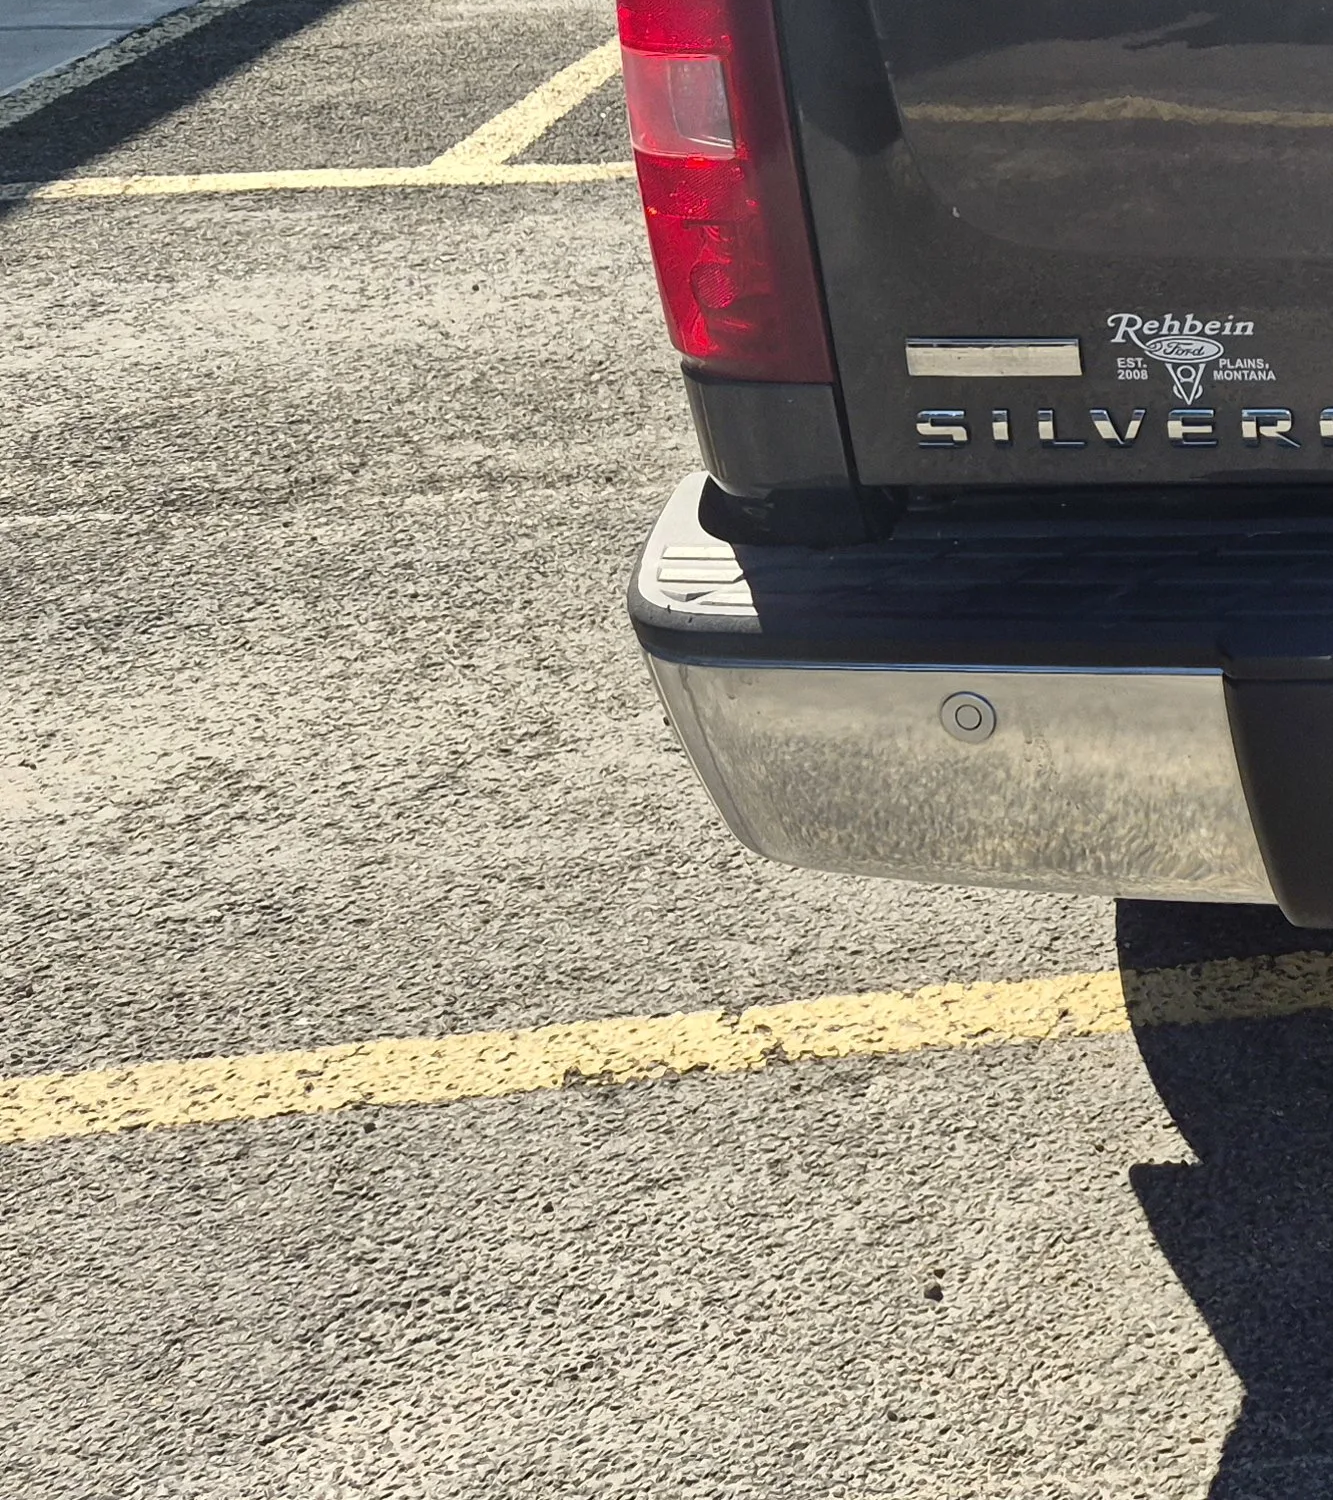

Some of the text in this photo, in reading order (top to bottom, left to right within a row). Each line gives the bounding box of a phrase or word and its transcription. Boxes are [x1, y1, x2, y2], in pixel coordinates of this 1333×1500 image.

[1107, 313, 1255, 350] Rehbein
[1116, 357, 1148, 369] EST.
[1218, 358, 1270, 370] PLAINS,
[1117, 369, 1149, 380] 2008
[1213, 370, 1277, 381] MONTANA
